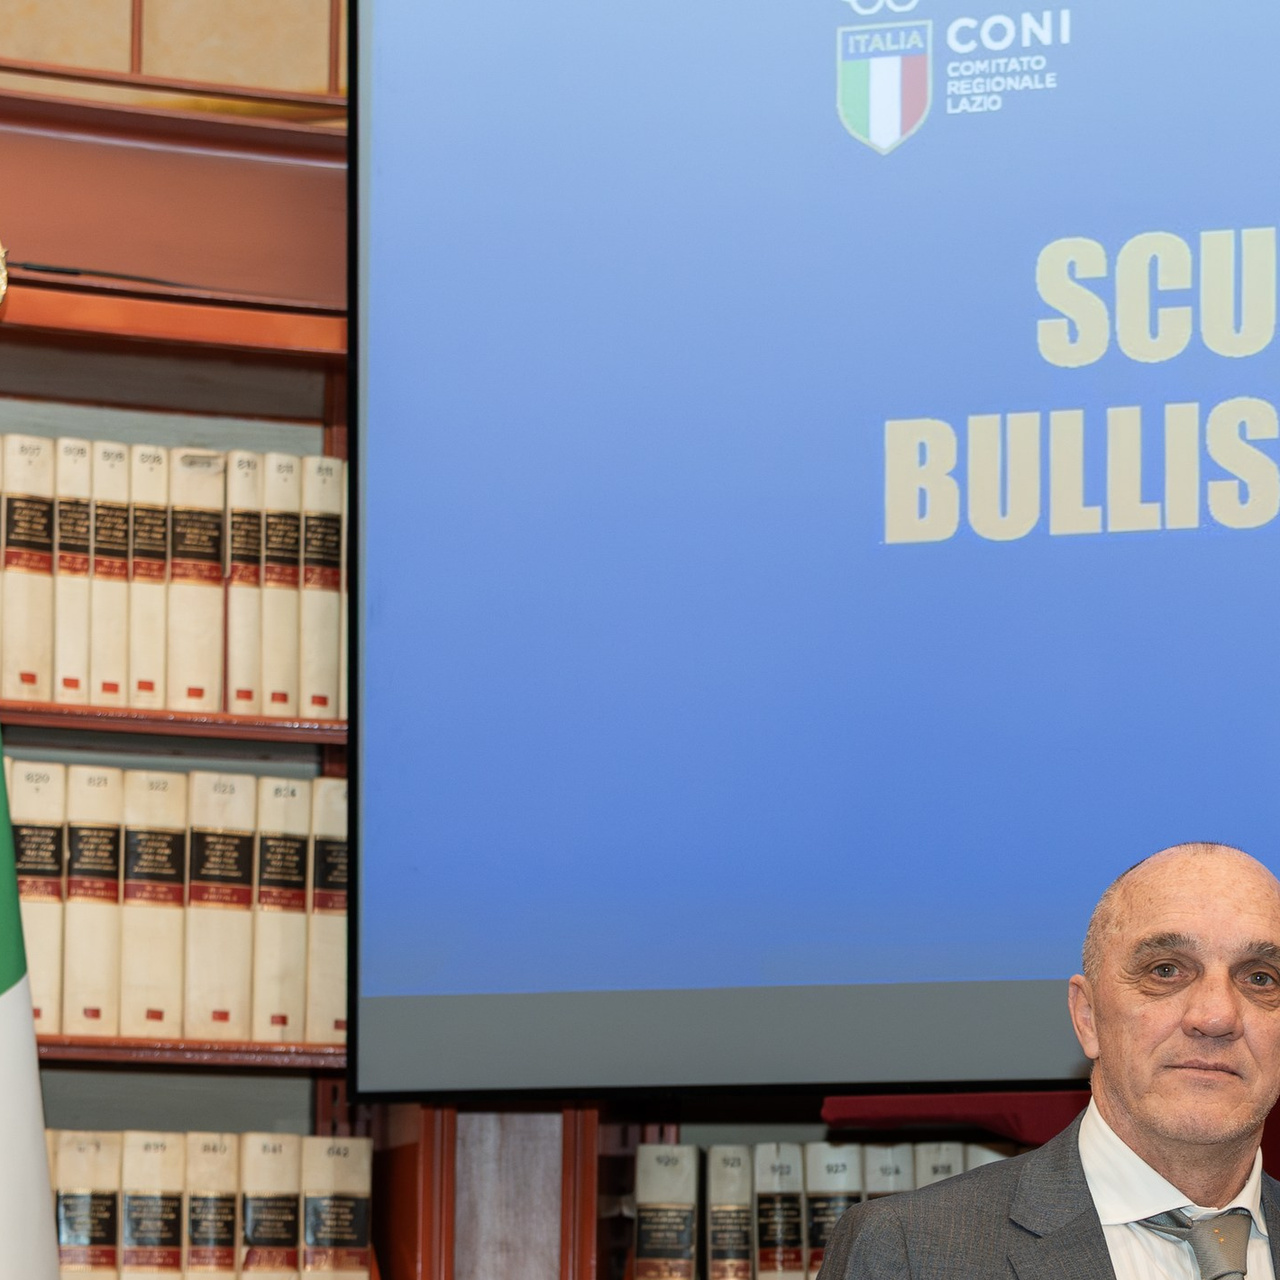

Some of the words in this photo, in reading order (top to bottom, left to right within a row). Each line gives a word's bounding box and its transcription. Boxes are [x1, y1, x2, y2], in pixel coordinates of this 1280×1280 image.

[848, 30, 924, 53] ITALIA
[947, 9, 1070, 53] CONI
[946, 55, 1047, 77] COMITATO
[946, 72, 1058, 96] REGIONALE
[946, 94, 1003, 114] LAZIO
